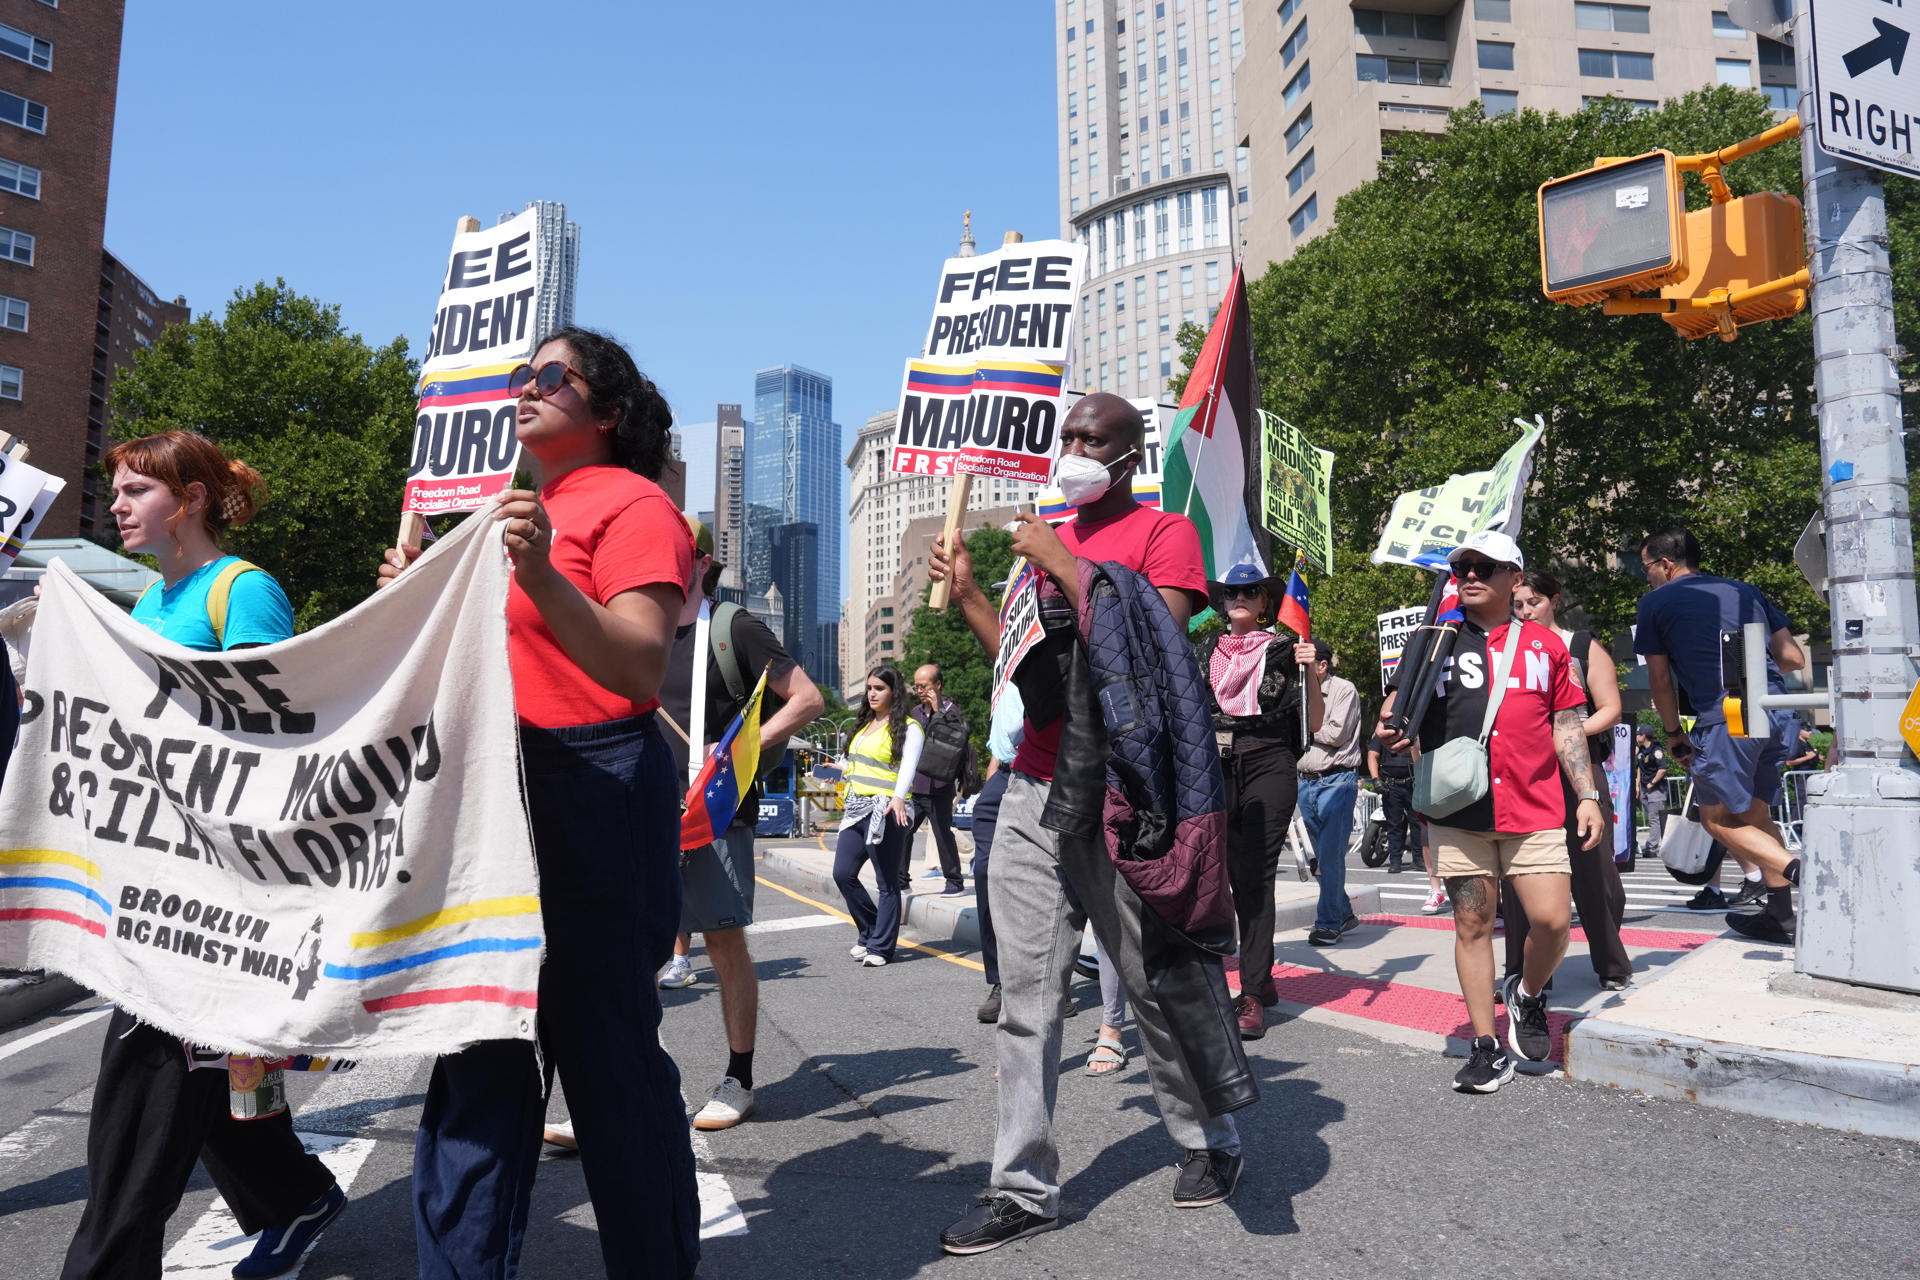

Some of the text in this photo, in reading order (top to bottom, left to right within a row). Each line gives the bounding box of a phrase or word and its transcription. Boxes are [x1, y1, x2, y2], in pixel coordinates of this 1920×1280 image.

[940, 256, 1073, 303] FREE
[928, 303, 1073, 355] PRESIDENT
[408, 405, 517, 477] DURO
[898, 394, 1057, 454] MADURO
[1264, 411, 1294, 447] FREE
[956, 461, 992, 473] Socialist
[992, 464, 1047, 482] Organization
[958, 453, 1020, 468] Freedom Road
[1268, 432, 1326, 496] MADURO &
[409, 498, 452, 509] Socialist
[411, 483, 481, 498] Freedom Road
[1267, 480, 1287, 503] FIRST
[1269, 496, 1326, 552] CILIA FLORES
[758, 804, 778, 816] PD
[119, 885, 270, 943] BROOKLYN
[116, 916, 294, 985] AGAINST WAR
